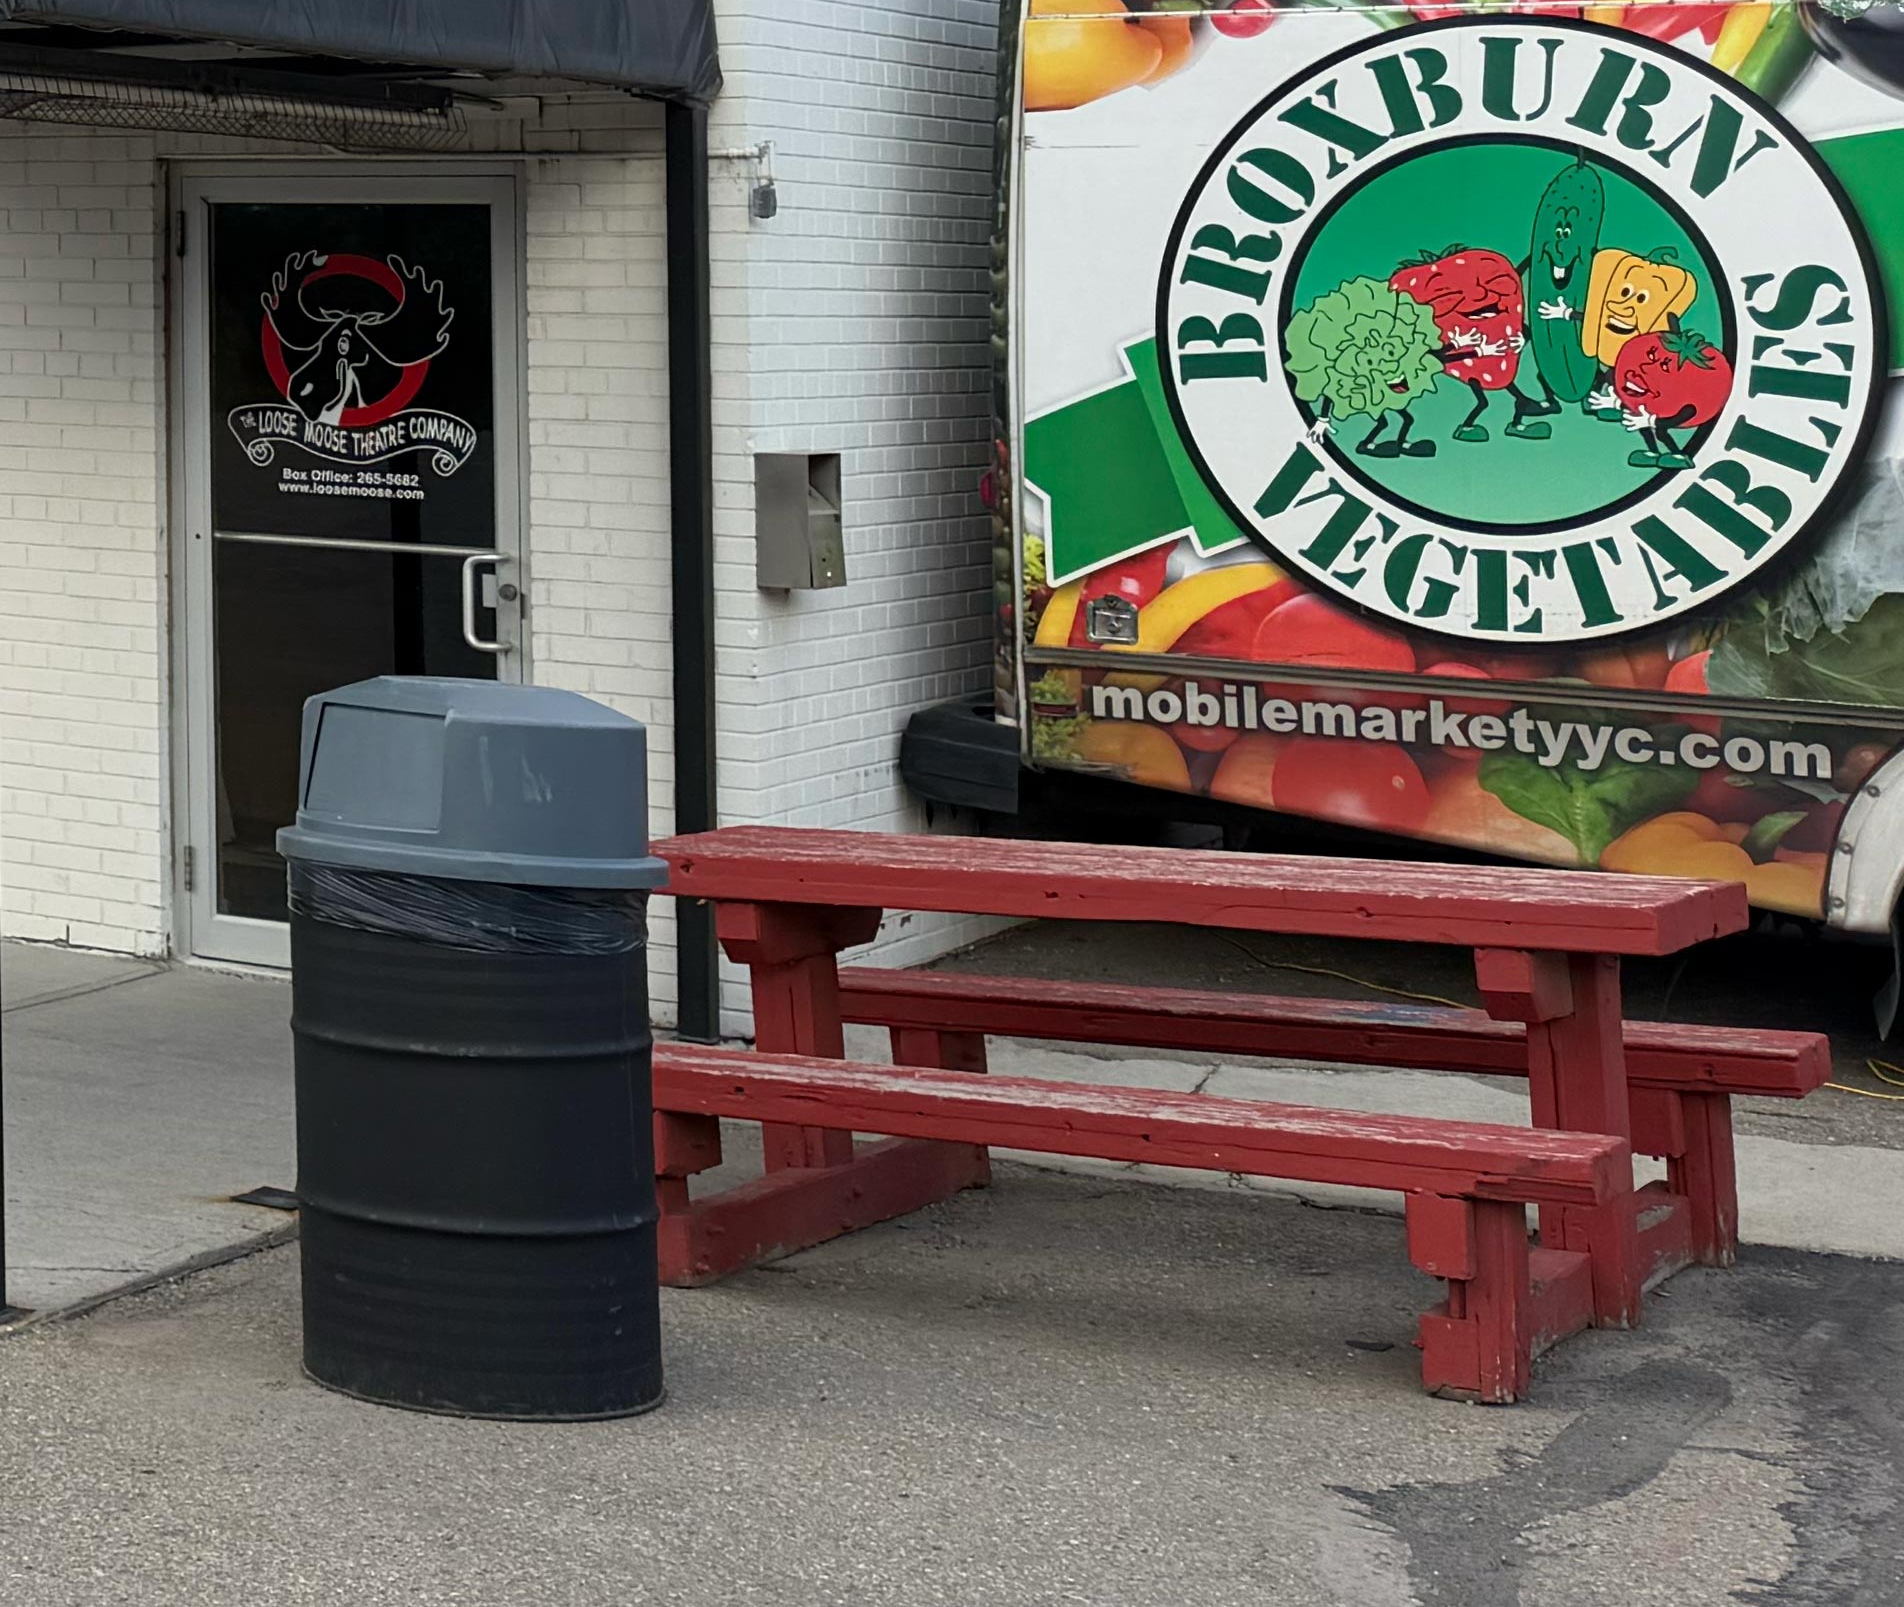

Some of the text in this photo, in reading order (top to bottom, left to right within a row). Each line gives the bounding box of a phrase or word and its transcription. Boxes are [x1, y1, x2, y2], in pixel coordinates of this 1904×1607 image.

[1178, 35, 1780, 387] BROXBURN
[258, 410, 297, 436] LOOSE
[304, 422, 347, 456] MOOSE
[351, 422, 406, 457] THEATRE
[409, 417, 476, 453] COMPANY
[1249, 262, 1855, 634] VEGETABLES
[278, 481, 425, 500] www.loosemoose.com
[282, 467, 308, 481] Box
[311, 469, 353, 483] Office:
[1092, 681, 1833, 779] mobilemarketyyc.com
